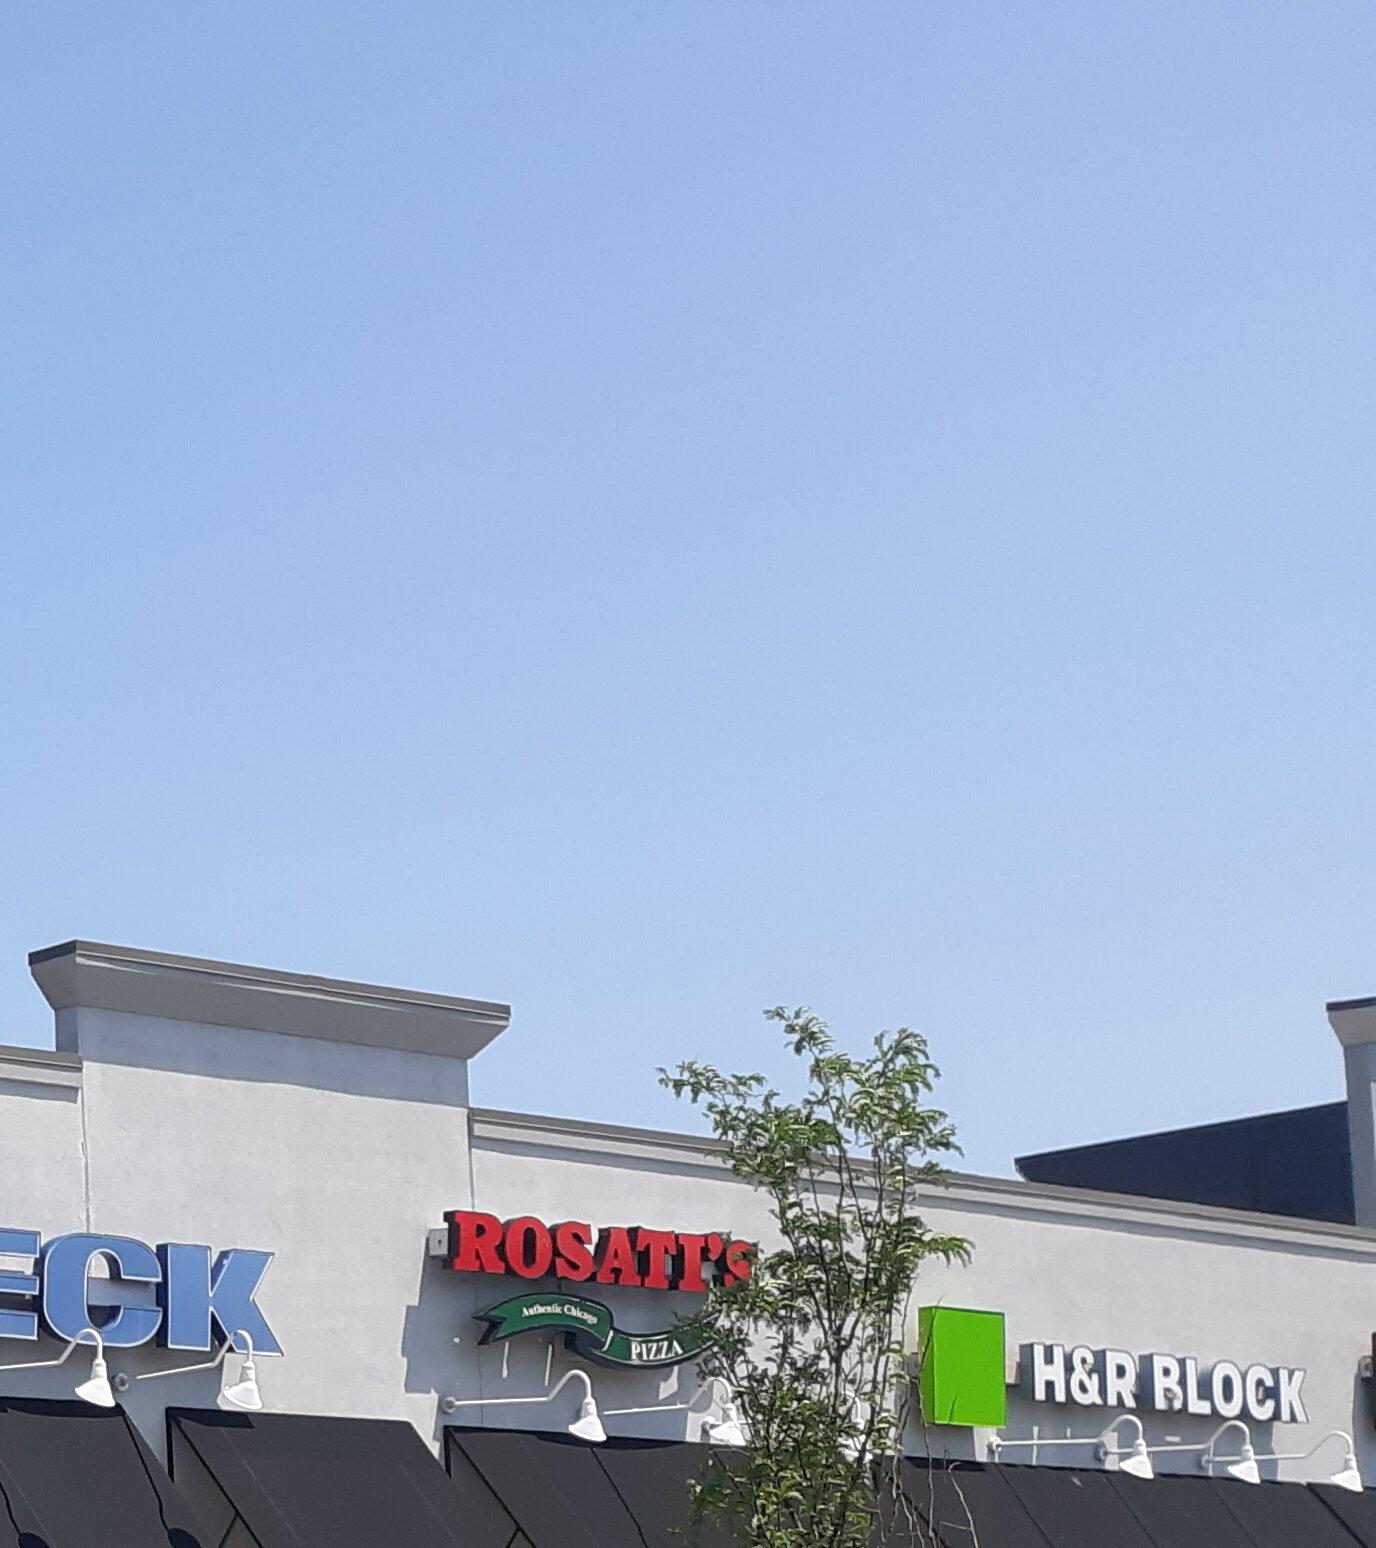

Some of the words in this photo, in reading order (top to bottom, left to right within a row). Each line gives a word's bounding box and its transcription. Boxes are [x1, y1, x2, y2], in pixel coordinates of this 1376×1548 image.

[520, 1300, 562, 1318] Authentic
[563, 1303, 599, 1325] Chicago
[629, 1338, 683, 1363] PIZZA
[1020, 1341, 1139, 1411] H&R
[1142, 1351, 1311, 1424] BLOCK
